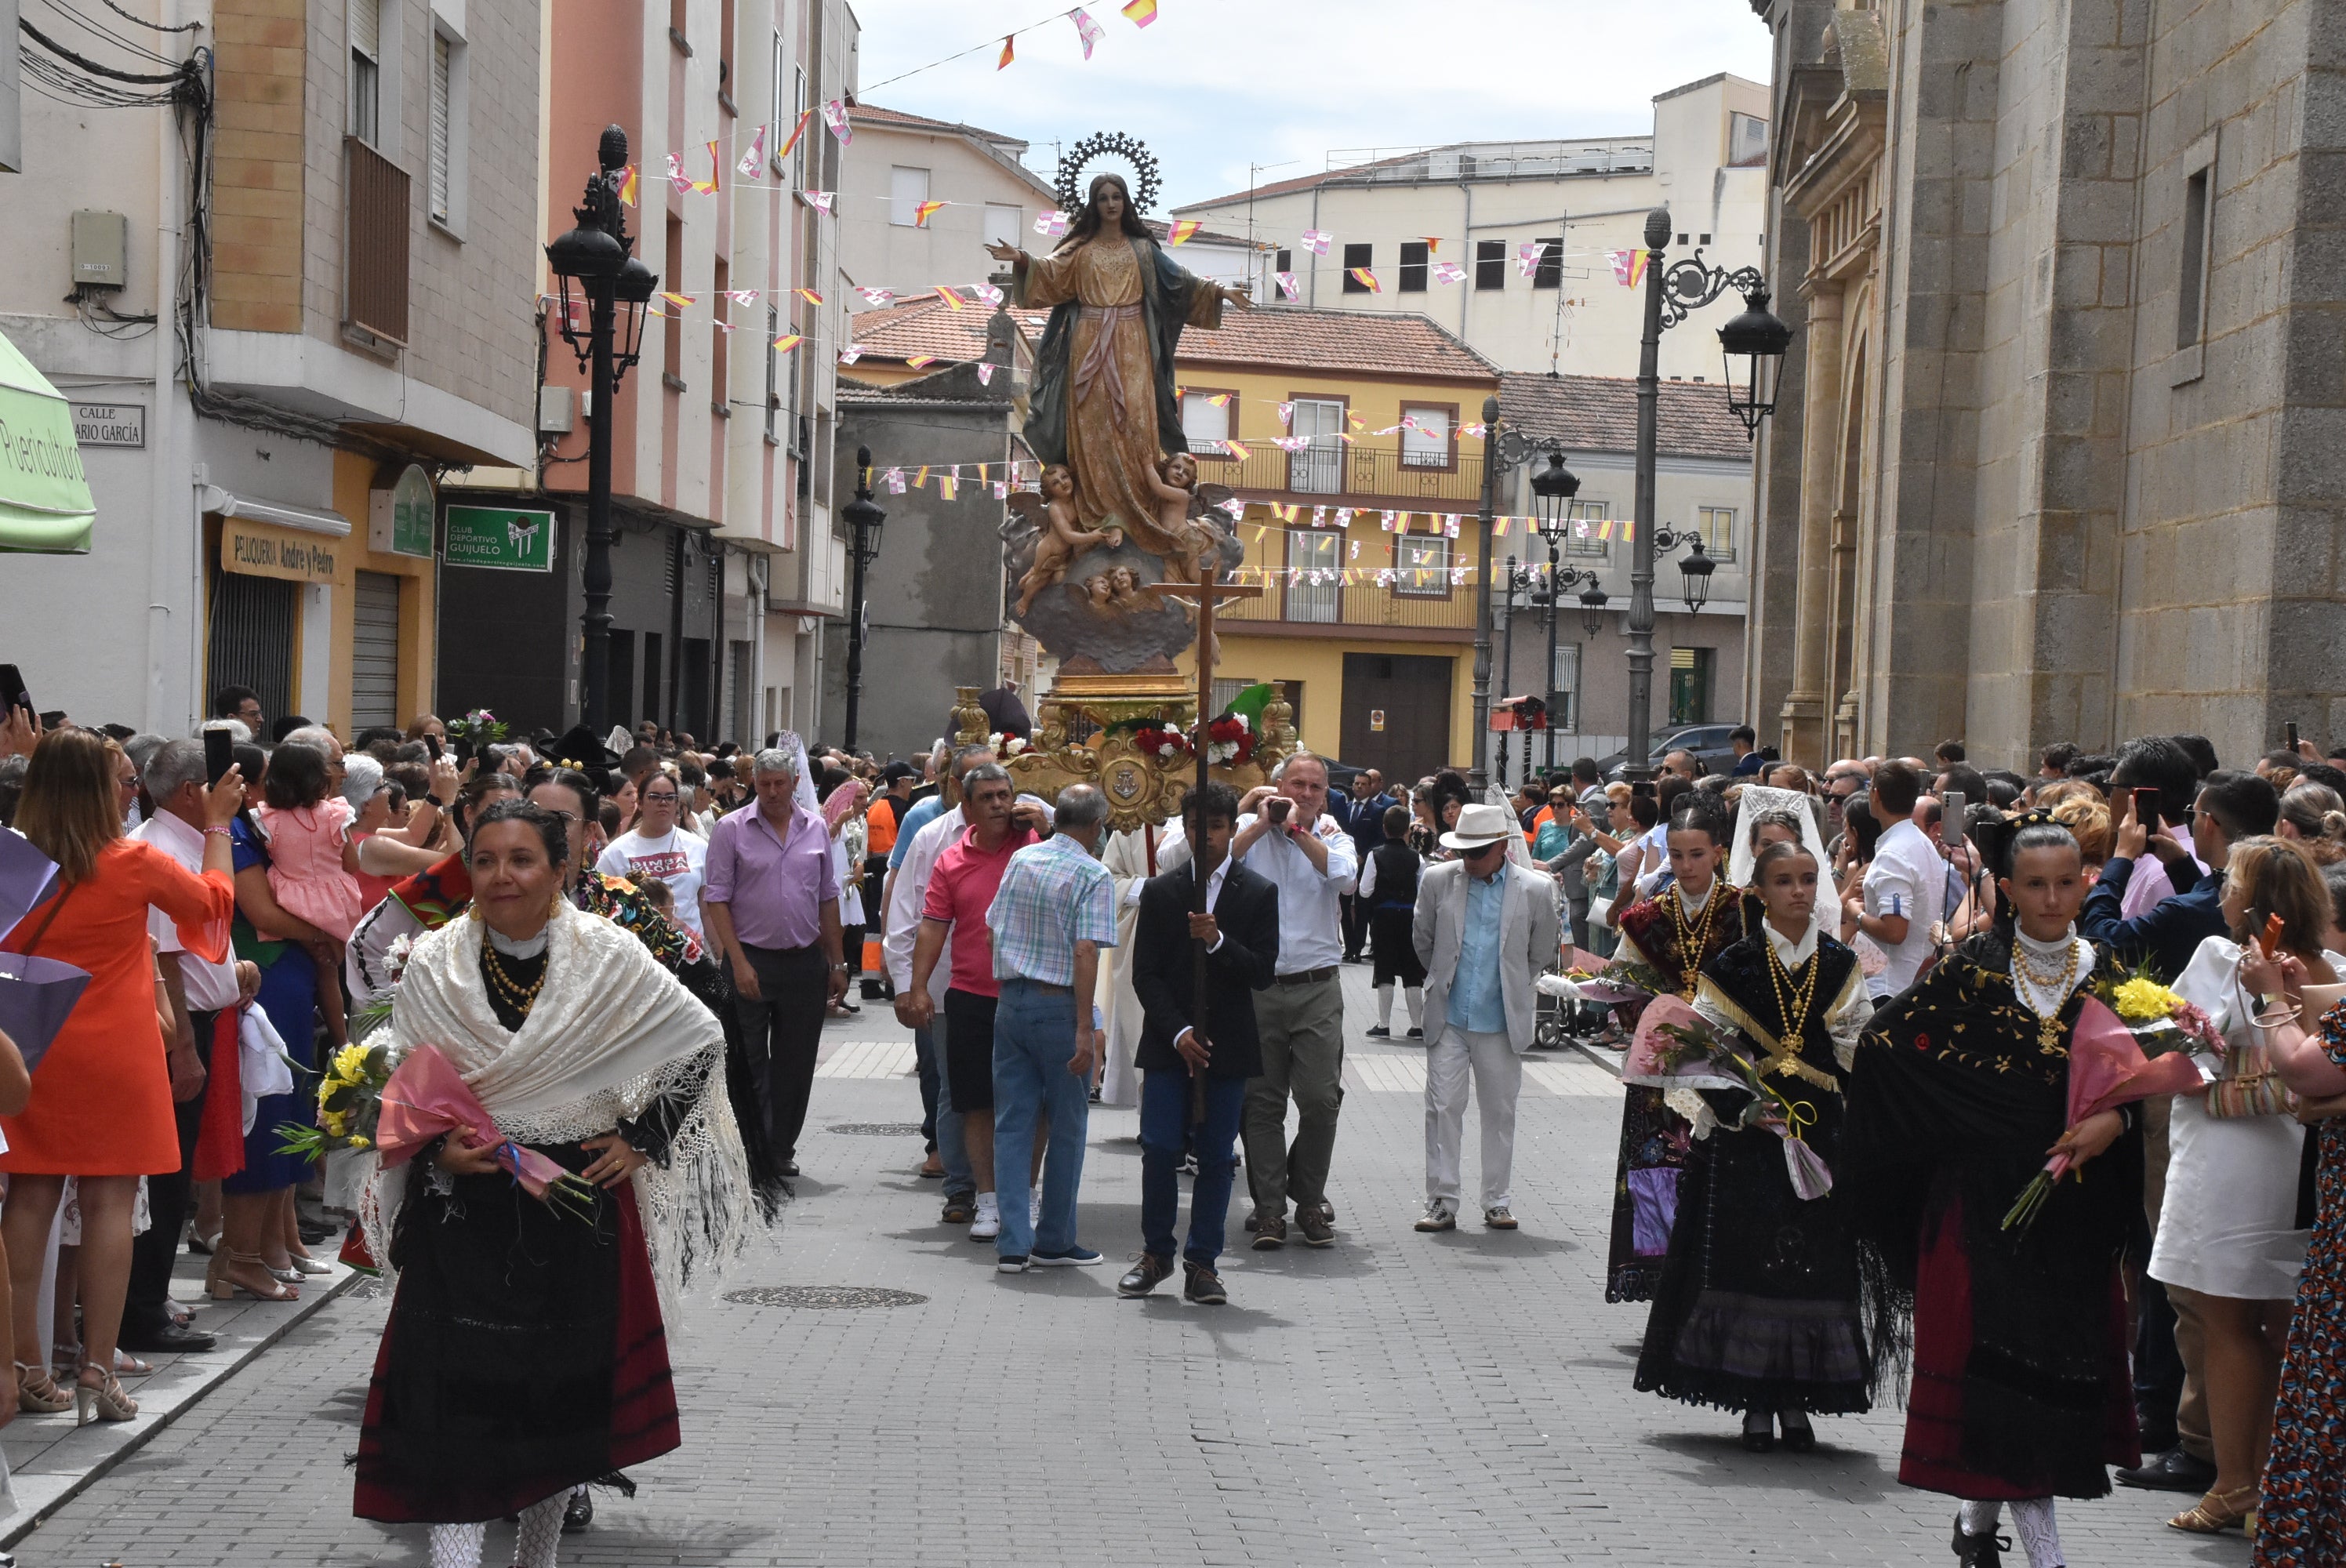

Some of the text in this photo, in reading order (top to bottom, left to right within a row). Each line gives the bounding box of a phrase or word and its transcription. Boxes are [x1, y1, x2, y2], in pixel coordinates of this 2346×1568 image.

[79, 407, 116, 419] CALLE
[74, 422, 140, 442] ARIO GARCÍA
[450, 525, 473, 534] CLUB
[450, 534, 497, 544] DEPORTIVO
[449, 543, 501, 555] GUIJUELO
[306, 550, 311, 578] y
[312, 544, 334, 575] Pedro
[631, 856, 688, 870] BIMBA
[645, 862, 687, 873] LOLA
